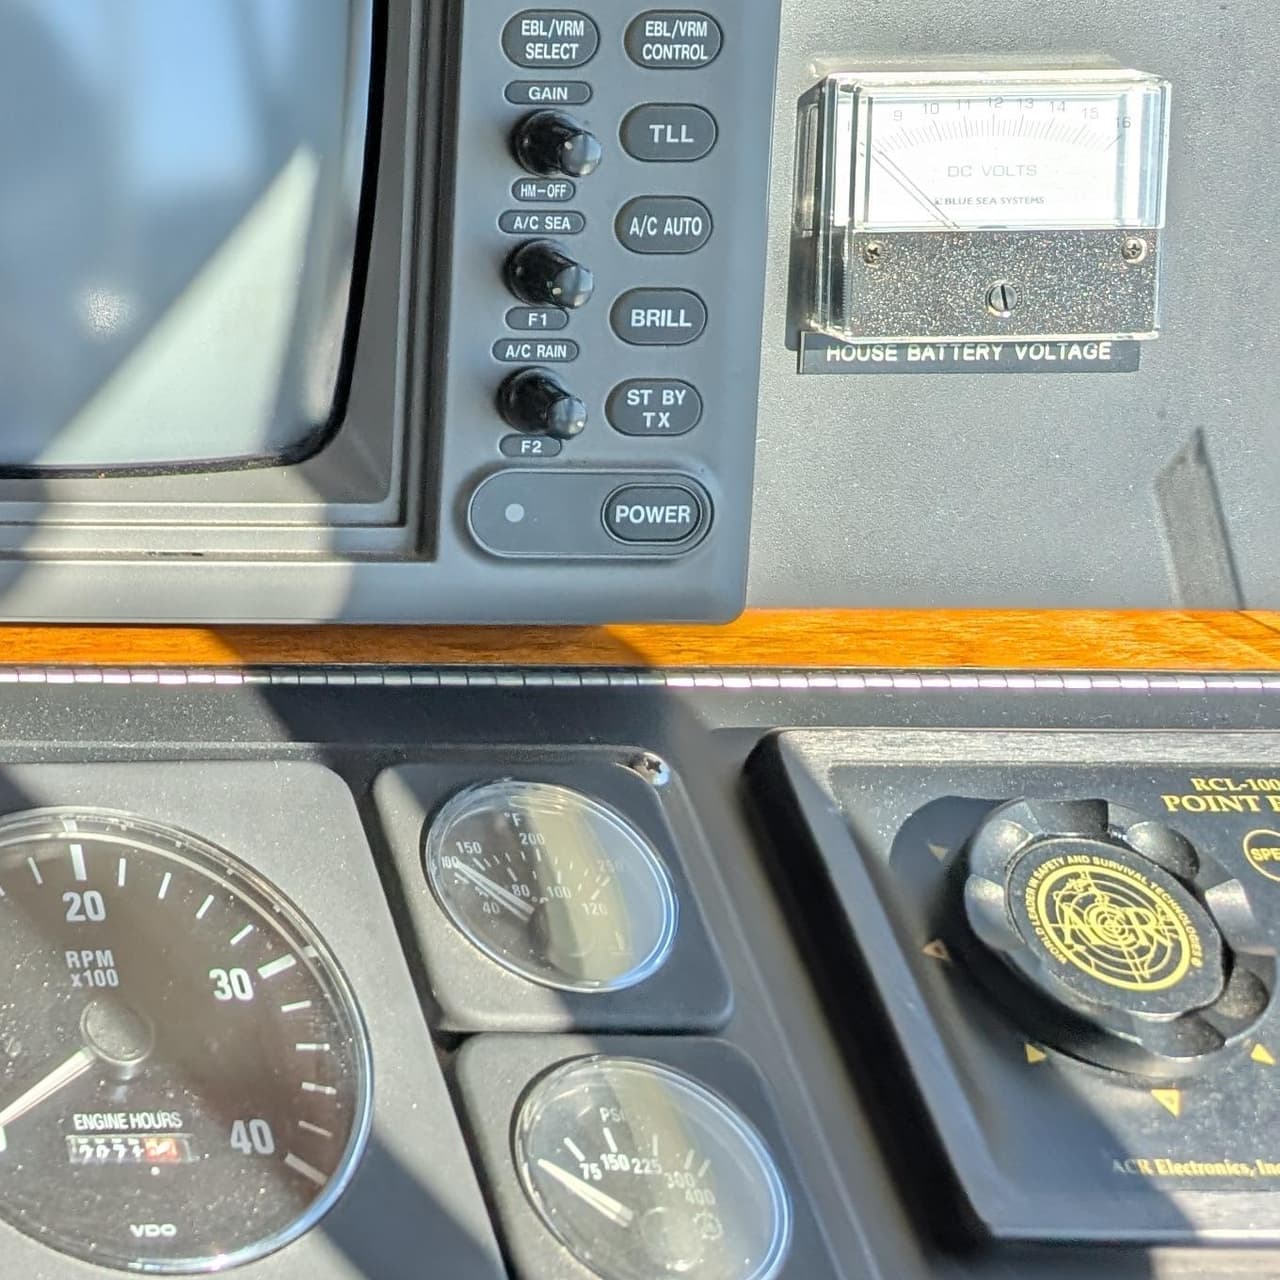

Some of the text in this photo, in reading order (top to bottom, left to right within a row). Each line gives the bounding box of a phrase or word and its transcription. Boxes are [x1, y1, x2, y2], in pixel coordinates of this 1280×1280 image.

[521, 19, 584, 37] EBL/VRM
[645, 20, 708, 39] EBL/VRM
[525, 43, 578, 59] SELECT
[642, 44, 708, 60] CONTROL
[528, 87, 568, 100] GAIN
[922, 103, 939, 115] 10
[957, 99, 971, 110] 11
[987, 97, 1003, 109] 12
[1017, 98, 1034, 110] 13
[1049, 100, 1066, 113] 14
[894, 110, 903, 121] 9
[1081, 107, 1099, 119] 15
[1116, 117, 1131, 129] 16
[649, 124, 694, 143] TLL
[947, 165, 1037, 177] DC VOLTS
[521, 184, 566, 197] HM-OFF
[945, 197, 973, 205] BLUE
[1001, 196, 1045, 204] SYSTEMS
[514, 216, 570, 230] A/C SEA
[630, 215, 702, 237] A/C AUTO
[528, 313, 547, 326] F1
[631, 309, 692, 327] BRILL
[505, 345, 566, 359] A/C RAIN
[826, 342, 1111, 362] HOUSE BATTERY VOLTAGE
[627, 389, 686, 405] ST BY
[521, 440, 541, 453] F2
[615, 505, 690, 523] POWER
[1191, 778, 1280, 791] RCL-100
[1160, 795, 1261, 812] POINT
[519, 833, 545, 845] 200
[456, 842, 482, 854] 150
[1067, 855, 1090, 864] AND
[1033, 857, 1064, 879] SAFETY
[1092, 856, 1148, 885] SURVIVAL
[512, 884, 530, 897] 80
[547, 886, 572, 899] 100
[63, 890, 106, 923] 20
[582, 903, 608, 916] 120
[1025, 887, 1041, 925] LEADER
[1035, 927, 1067, 964] WORLD
[65, 950, 115, 968] RPM
[208, 969, 254, 1001] 30
[73, 1112, 183, 1130] ENGINE HOURS
[230, 1120, 275, 1155] 40
[600, 1153, 630, 1171] 150
[631, 1158, 661, 1174] 225
[1112, 1159, 1155, 1176] ACR
[579, 1163, 602, 1180] 75
[130, 1224, 177, 1237] VDO
